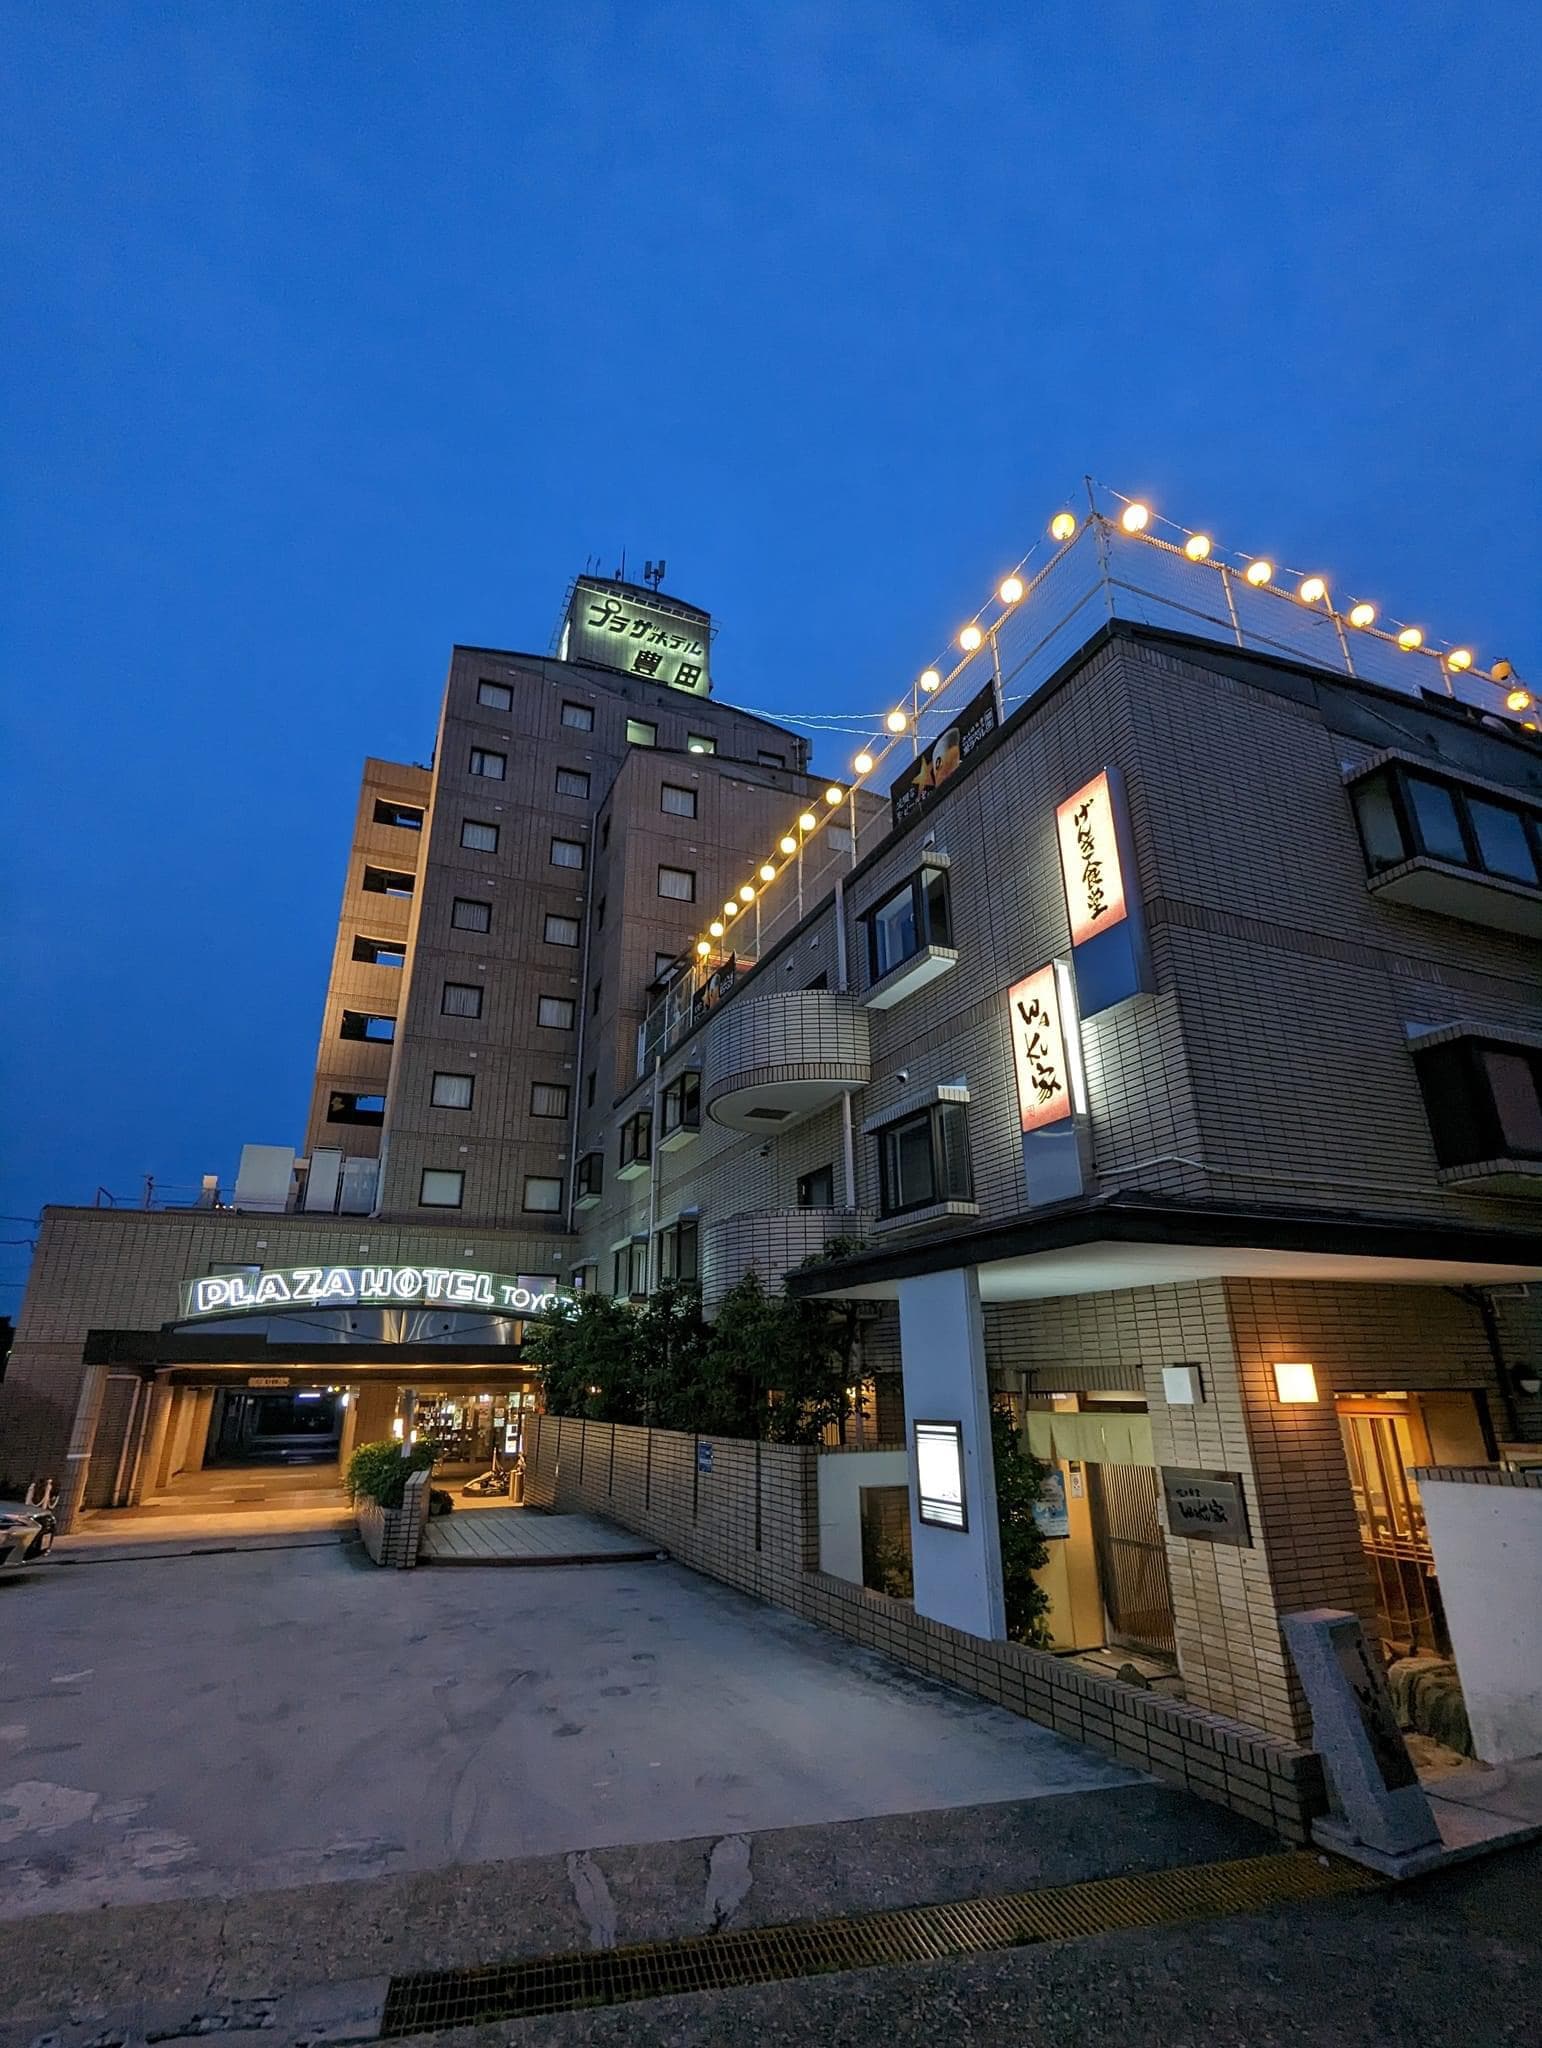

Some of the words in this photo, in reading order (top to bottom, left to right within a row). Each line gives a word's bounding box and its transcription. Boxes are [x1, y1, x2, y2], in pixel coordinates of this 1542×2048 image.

[587, 599, 702, 656] プラザホテル
[630, 649, 702, 688] 豊田
[198, 1268, 354, 1311] PLAZA
[360, 1267, 495, 1303] HOTEL
[501, 1285, 583, 1317] TOYOT
